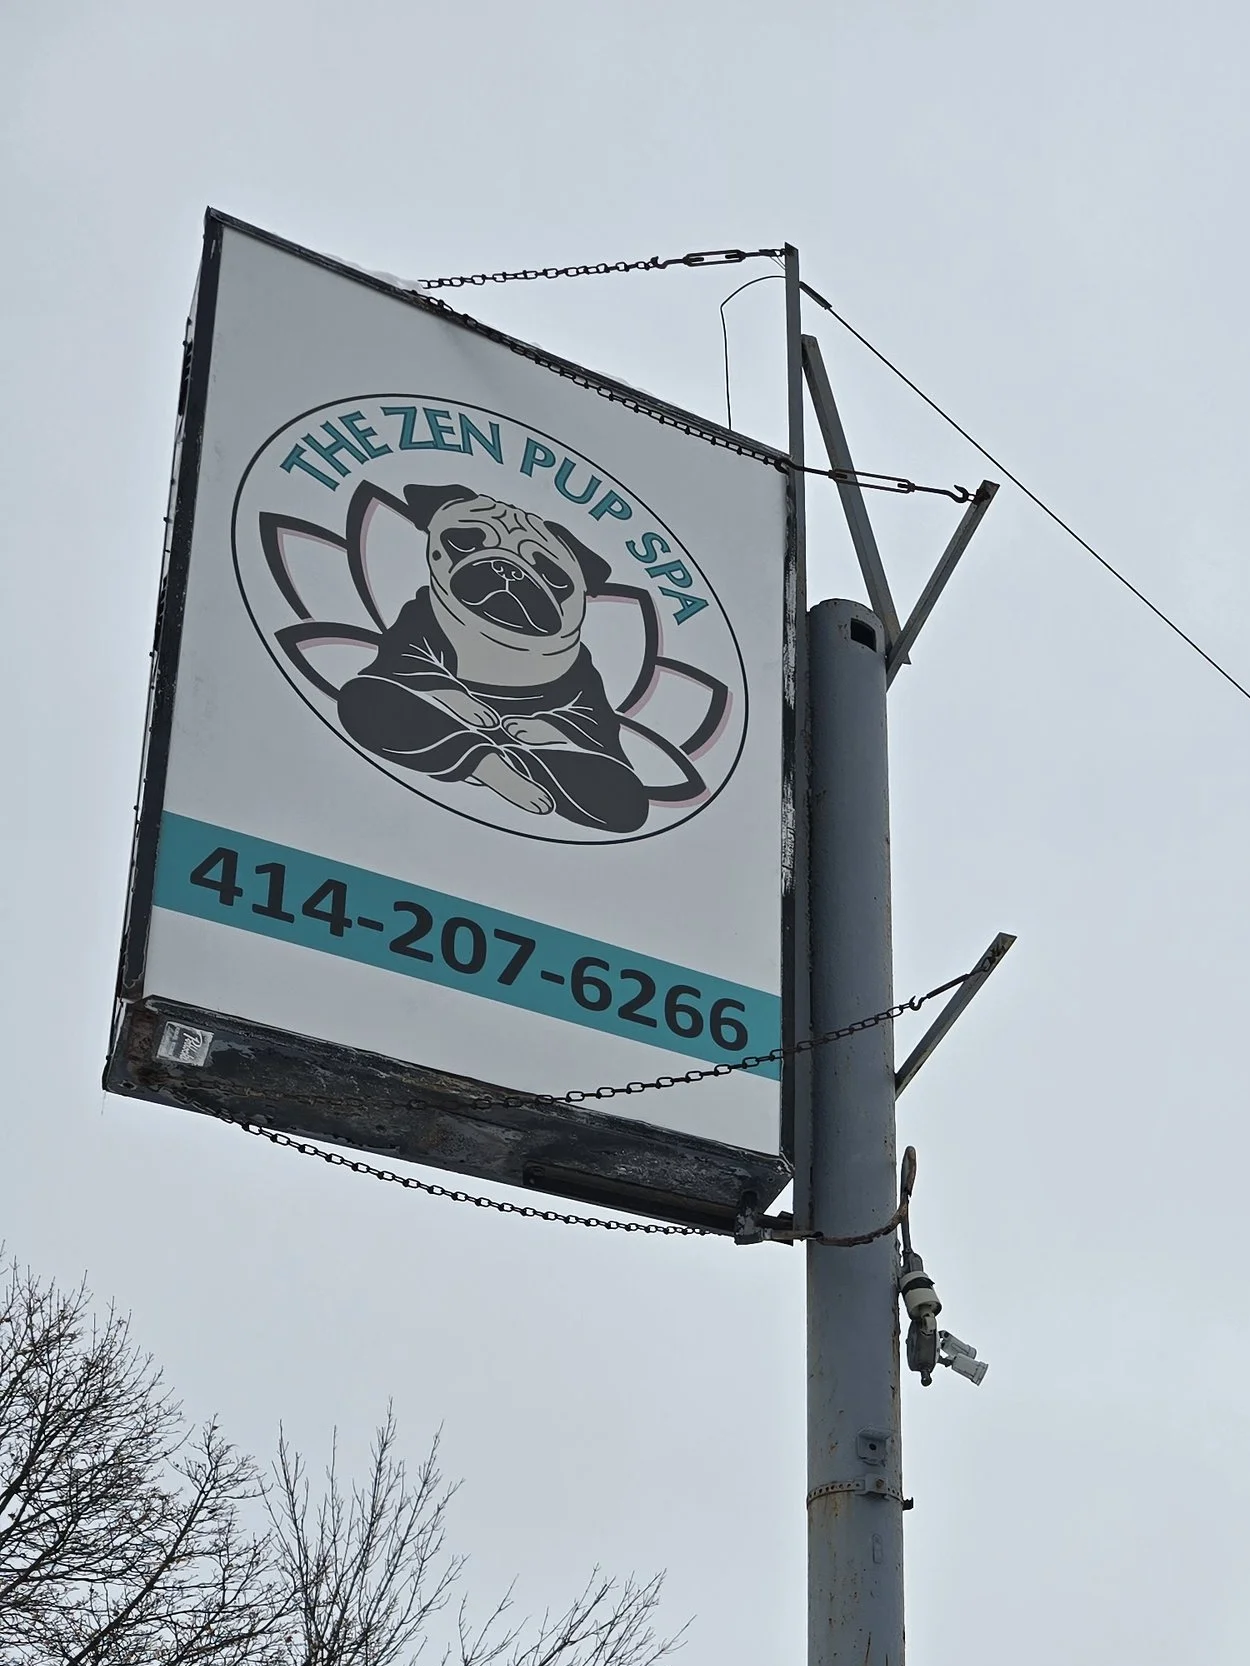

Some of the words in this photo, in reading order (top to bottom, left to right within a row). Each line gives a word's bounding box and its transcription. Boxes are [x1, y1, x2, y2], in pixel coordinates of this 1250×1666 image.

[279, 410, 393, 492] THE
[380, 406, 504, 465] ZEN
[519, 437, 633, 522] PUP
[625, 531, 710, 626] SPA
[189, 847, 750, 1052] 414-207-6266
